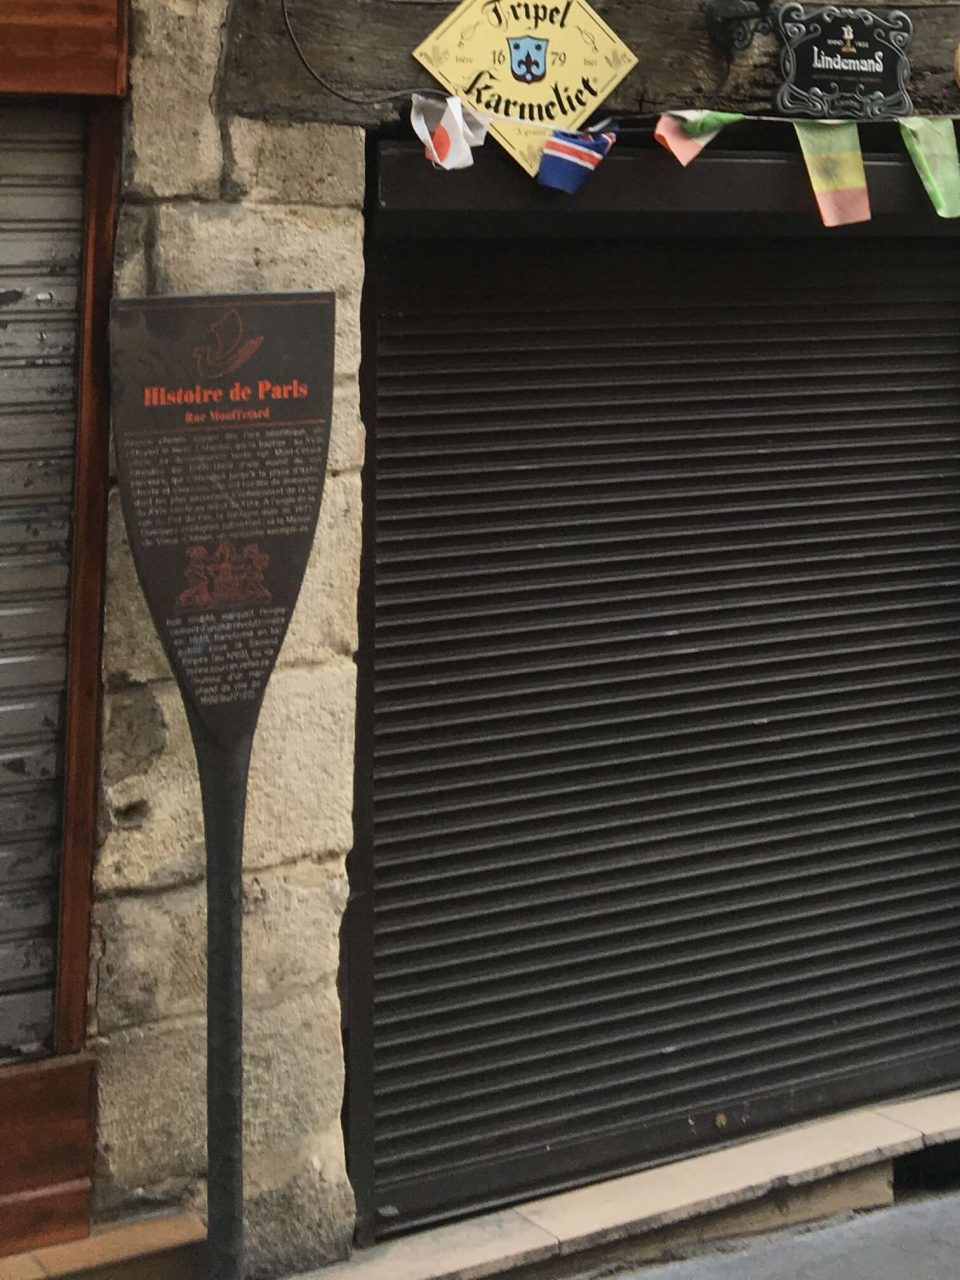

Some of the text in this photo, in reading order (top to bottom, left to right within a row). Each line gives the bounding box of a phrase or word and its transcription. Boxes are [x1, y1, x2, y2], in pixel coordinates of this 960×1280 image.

[490, 48, 567, 68] 16 79
[462, 69, 598, 122] Karmeliet
[144, 378, 309, 407] Histoire de Paris
